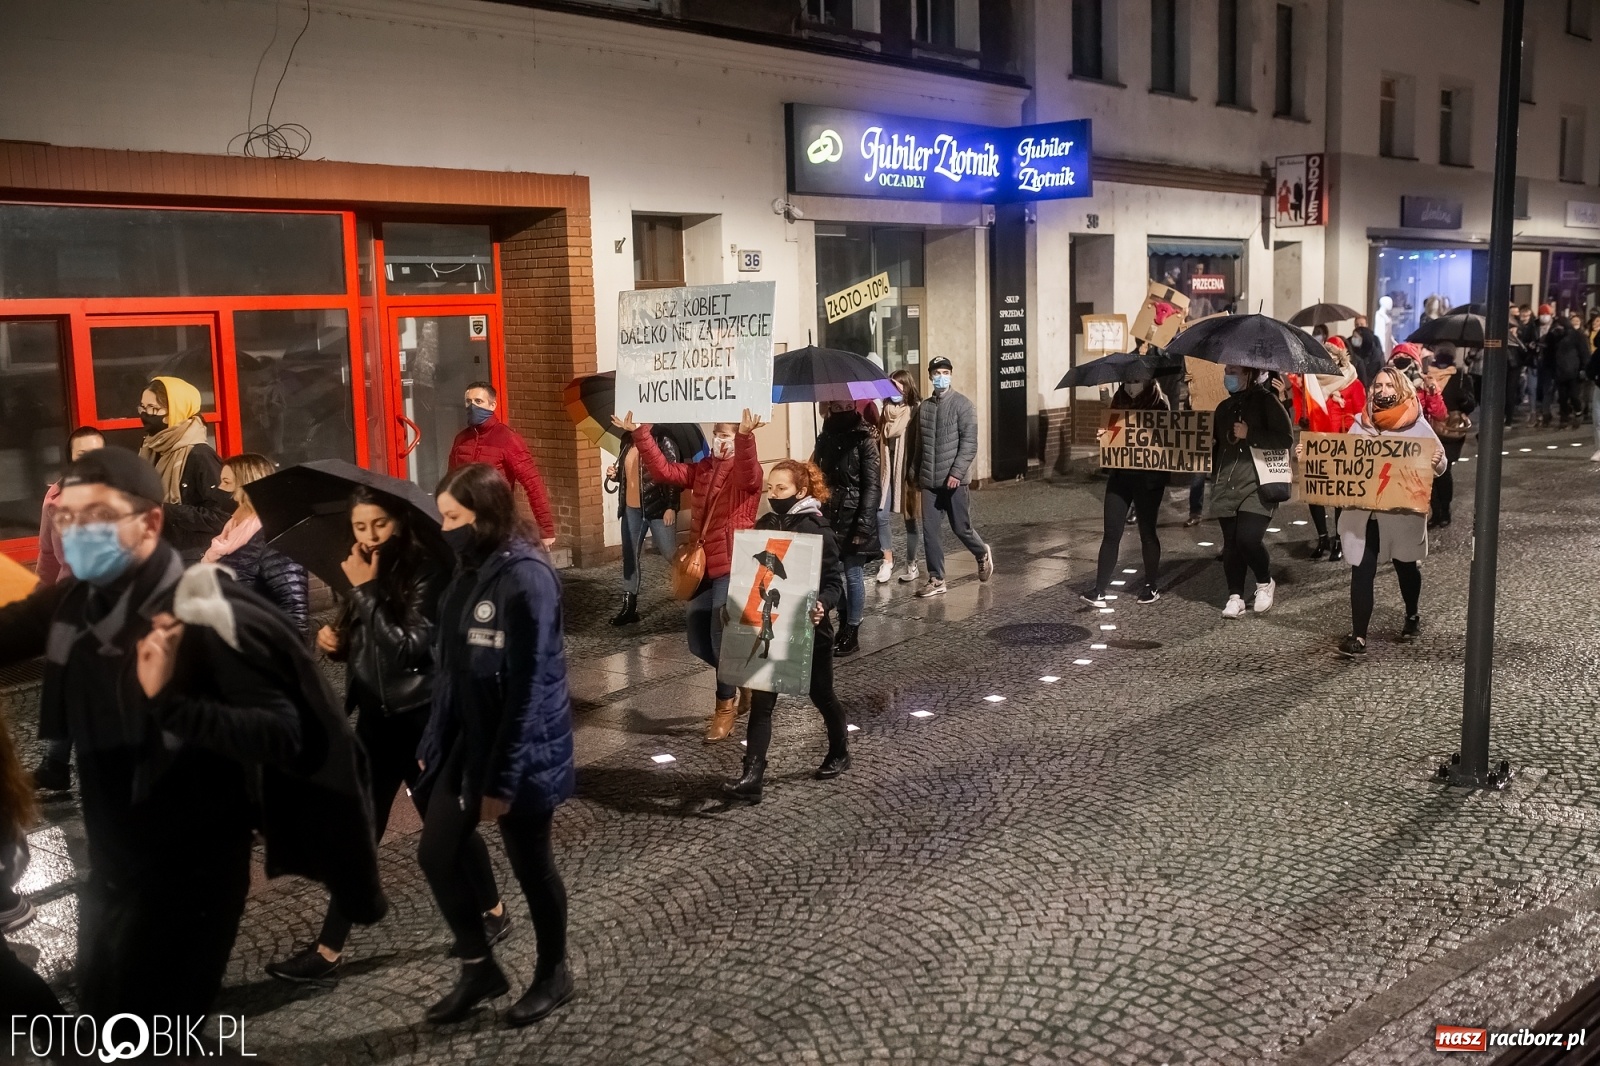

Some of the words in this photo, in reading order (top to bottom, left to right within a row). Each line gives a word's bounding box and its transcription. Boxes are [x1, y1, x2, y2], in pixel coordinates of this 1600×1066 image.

[860, 126, 933, 182] Jubiler
[934, 133, 1000, 182] Złotnik
[1018, 137, 1074, 167] Jubiler
[879, 173, 926, 189] OCZADŁY
[1018, 166, 1075, 193] Złotnik
[745, 254, 760, 267] 36
[1192, 278, 1225, 290] PRZECENA
[655, 300, 678, 319] BEZ
[683, 293, 731, 318] KOBIET
[827, 289, 862, 319] ZŁOTO
[864, 277, 889, 301] -10%
[620, 324, 667, 345] DALEKO
[672, 321, 692, 342] NIE
[699, 313, 771, 347] ZAJDZIECIE
[653, 351, 678, 371] BEZ
[682, 346, 735, 370] KOBIET
[638, 375, 737, 403] WYGINIECIE
[1101, 446, 1211, 472] WYPIERDALAJTE
[1306, 439, 1347, 457] MOJA
[1354, 438, 1422, 458] BROSZKA
[1305, 459, 1328, 475] NIE
[1333, 457, 1375, 480] TWÓJ
[1306, 480, 1366, 497] INTERES
